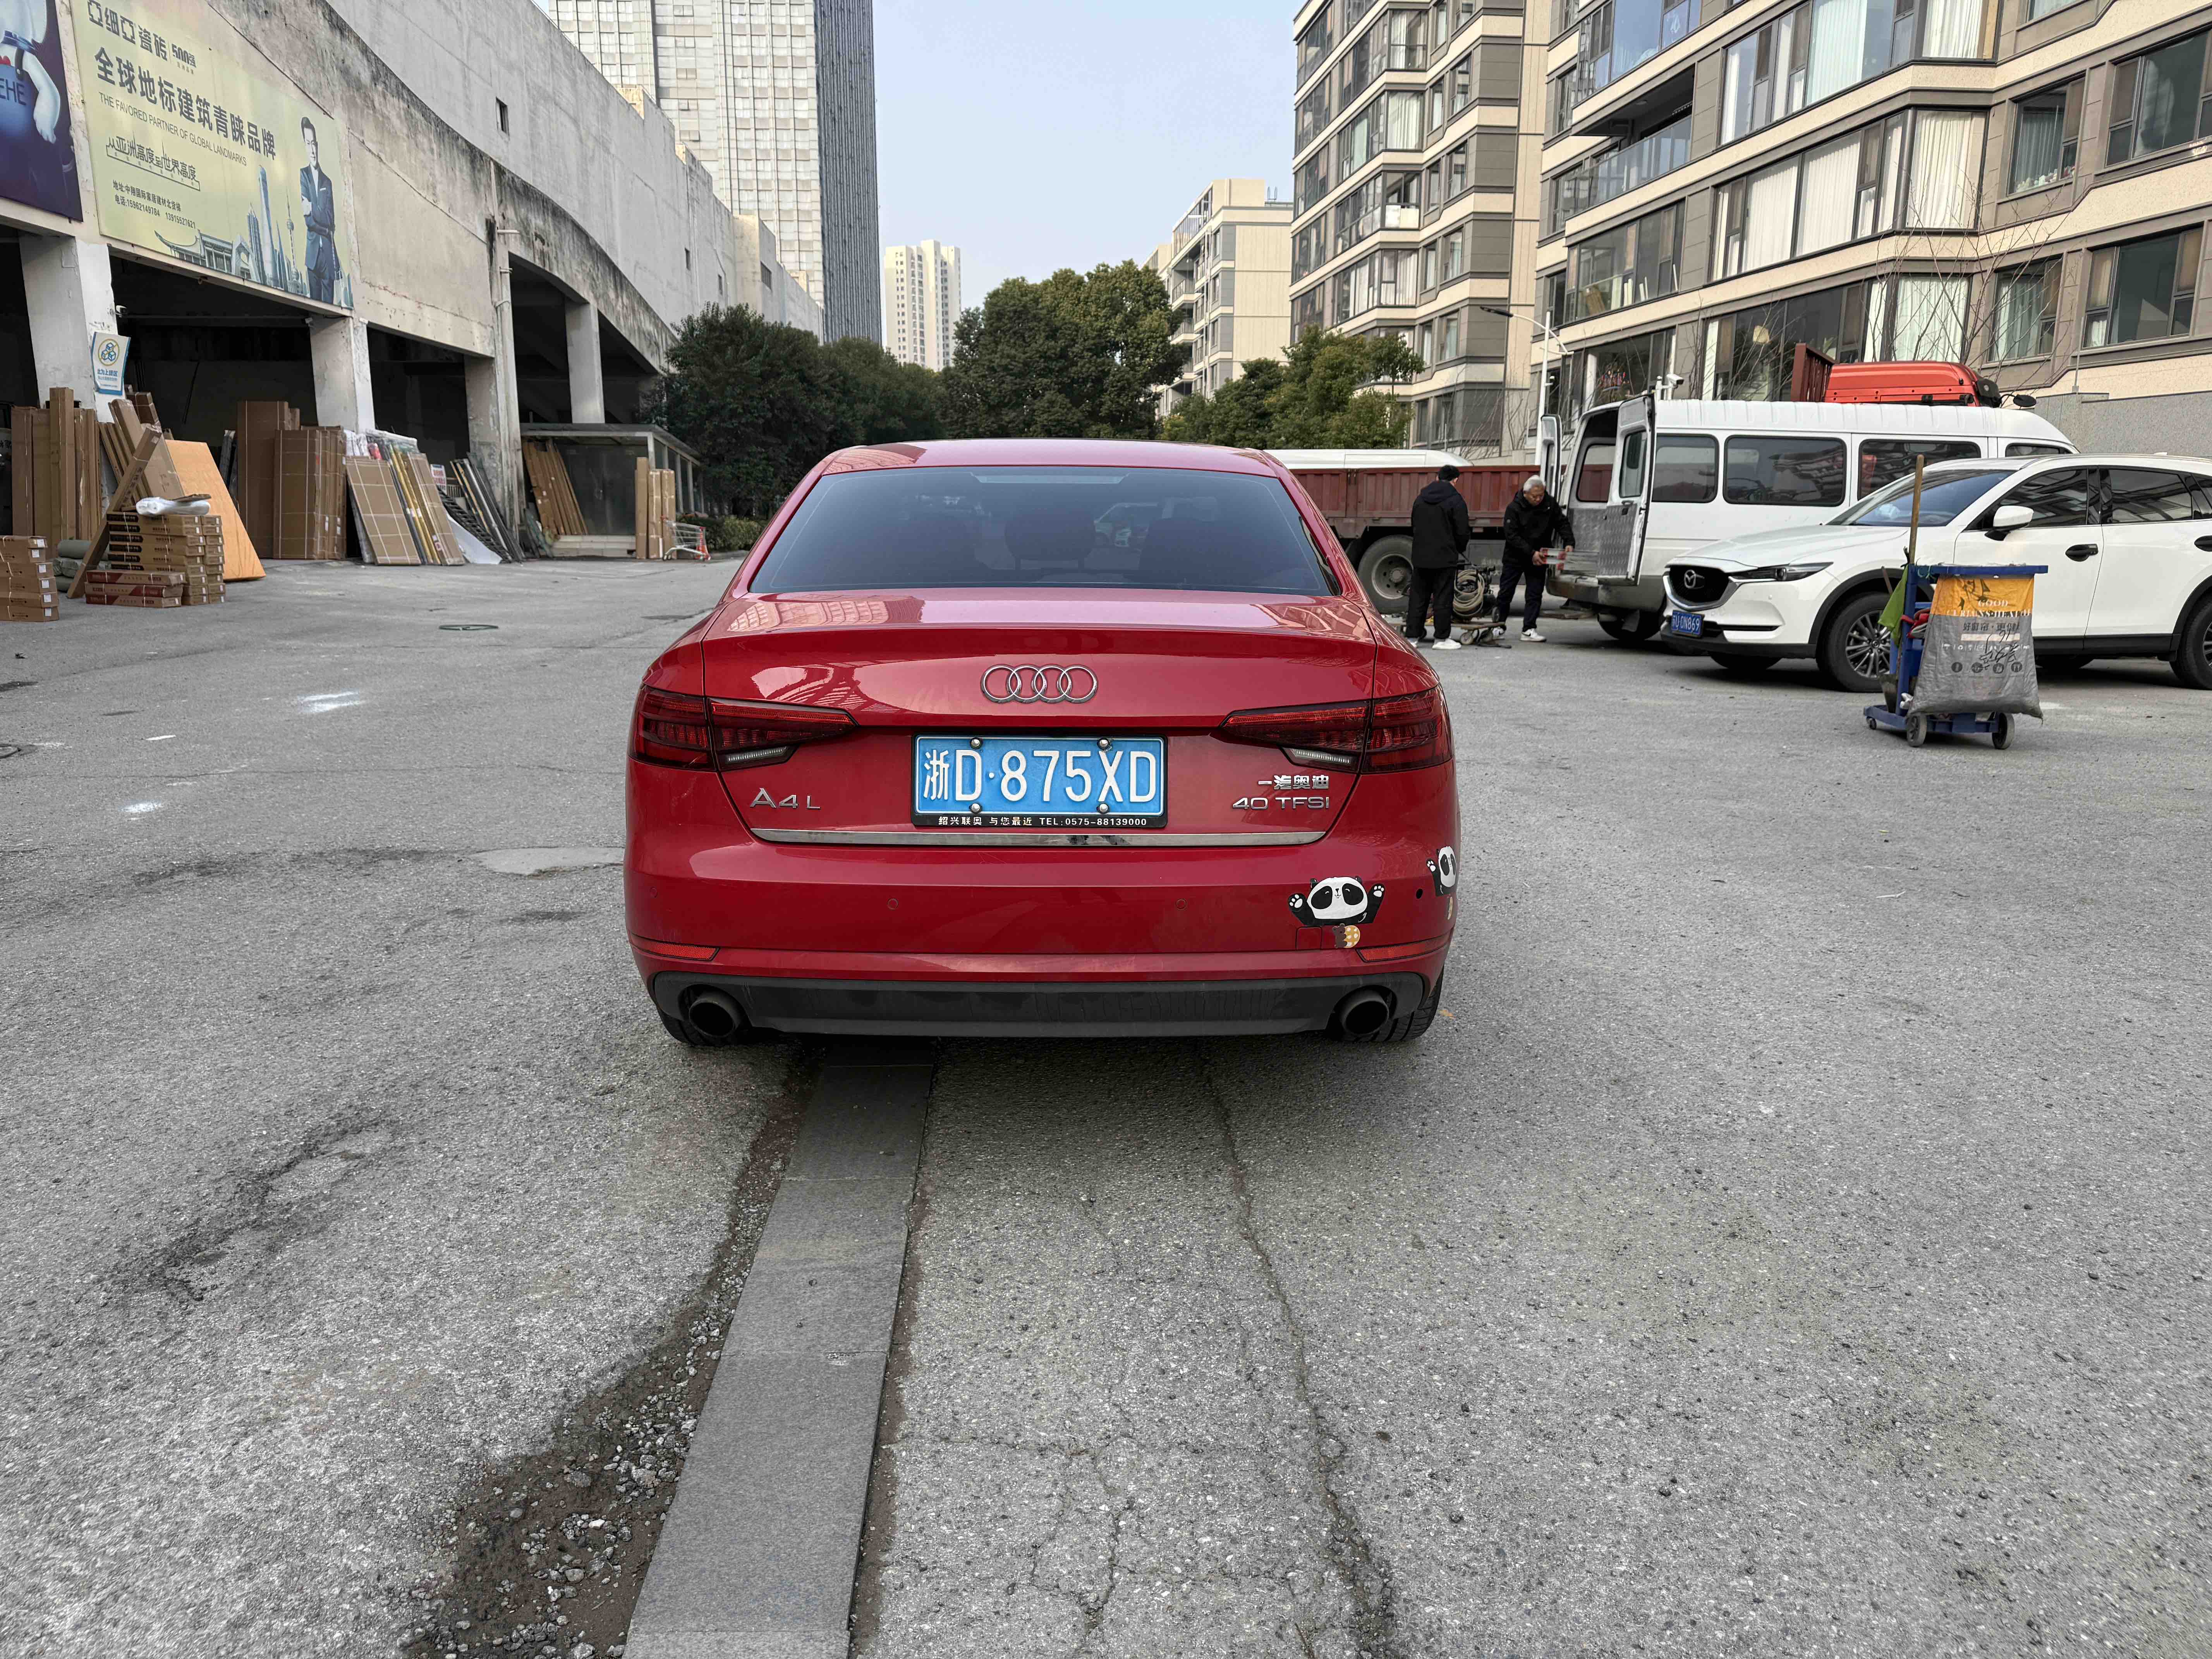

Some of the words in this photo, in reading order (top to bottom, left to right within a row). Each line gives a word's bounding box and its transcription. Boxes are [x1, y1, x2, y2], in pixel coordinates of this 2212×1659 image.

[94, 47, 276, 160] 全球地标建筑青睐品牌
[99, 92, 114, 108] THE
[116, 99, 148, 122] FAVORED
[149, 114, 179, 136] PARTNER
[180, 129, 188, 139] OF
[190, 133, 213, 151] GLOBAL
[213, 143, 247, 166] LANDMARKS
[108, 131, 196, 180] 从亚洲高度到世界高度
[166, 212, 196, 229] 13915527621
[923, 749, 1157, 802] 浙D·875XD
[1258, 775, 1329, 790] 一汽奥迪
[1233, 797, 1268, 809] 40
[1275, 797, 1329, 809] TFSI
[938, 816, 982, 826] 绍兴联奥
[989, 816, 1032, 826] 与您最近
